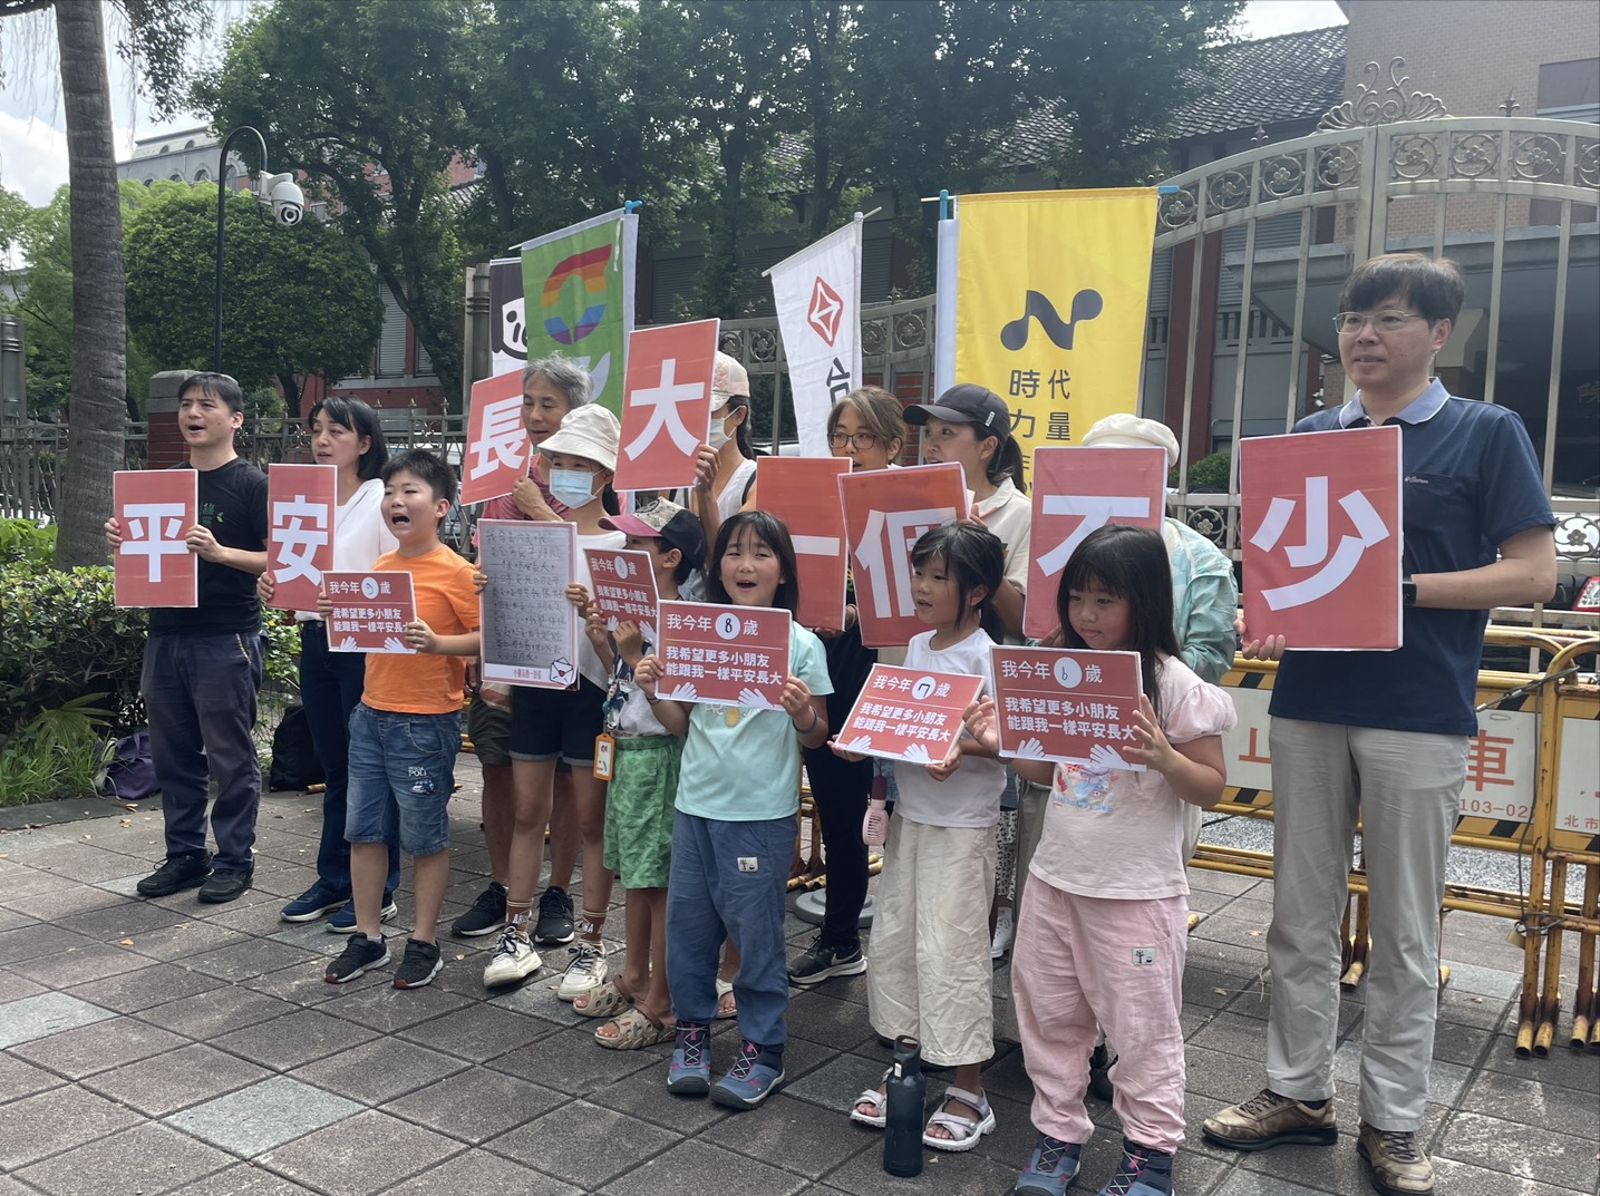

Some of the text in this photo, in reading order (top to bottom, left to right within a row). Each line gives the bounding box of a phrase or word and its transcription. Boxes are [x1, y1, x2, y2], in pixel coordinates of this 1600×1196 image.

[1009, 369, 1071, 400] 時代
[624, 359, 705, 461] 大
[470, 395, 528, 480] 長
[1009, 409, 1071, 441] 力量
[120, 503, 191, 583] 平
[272, 495, 328, 586] 安
[1249, 476, 1390, 611] 少
[667, 613, 759, 636] 我今年 8 歲
[666, 646, 770, 668] 我希望更多小朋友
[666, 663, 783, 685] 能跟我一樣平安長大
[873, 675, 912, 692] 我今年
[1001, 660, 1050, 680] 我今年
[1085, 664, 1103, 683] 歲
[860, 702, 948, 726] 我希望更多小朋友
[1005, 697, 1120, 721] 我希望更多小朋友
[852, 717, 951, 742] 能跟我一樣平安長大
[1007, 715, 1137, 741] 能跟我一樣平安長大
[1466, 729, 1515, 791] 車
[1459, 798, 1534, 818] 103-02
